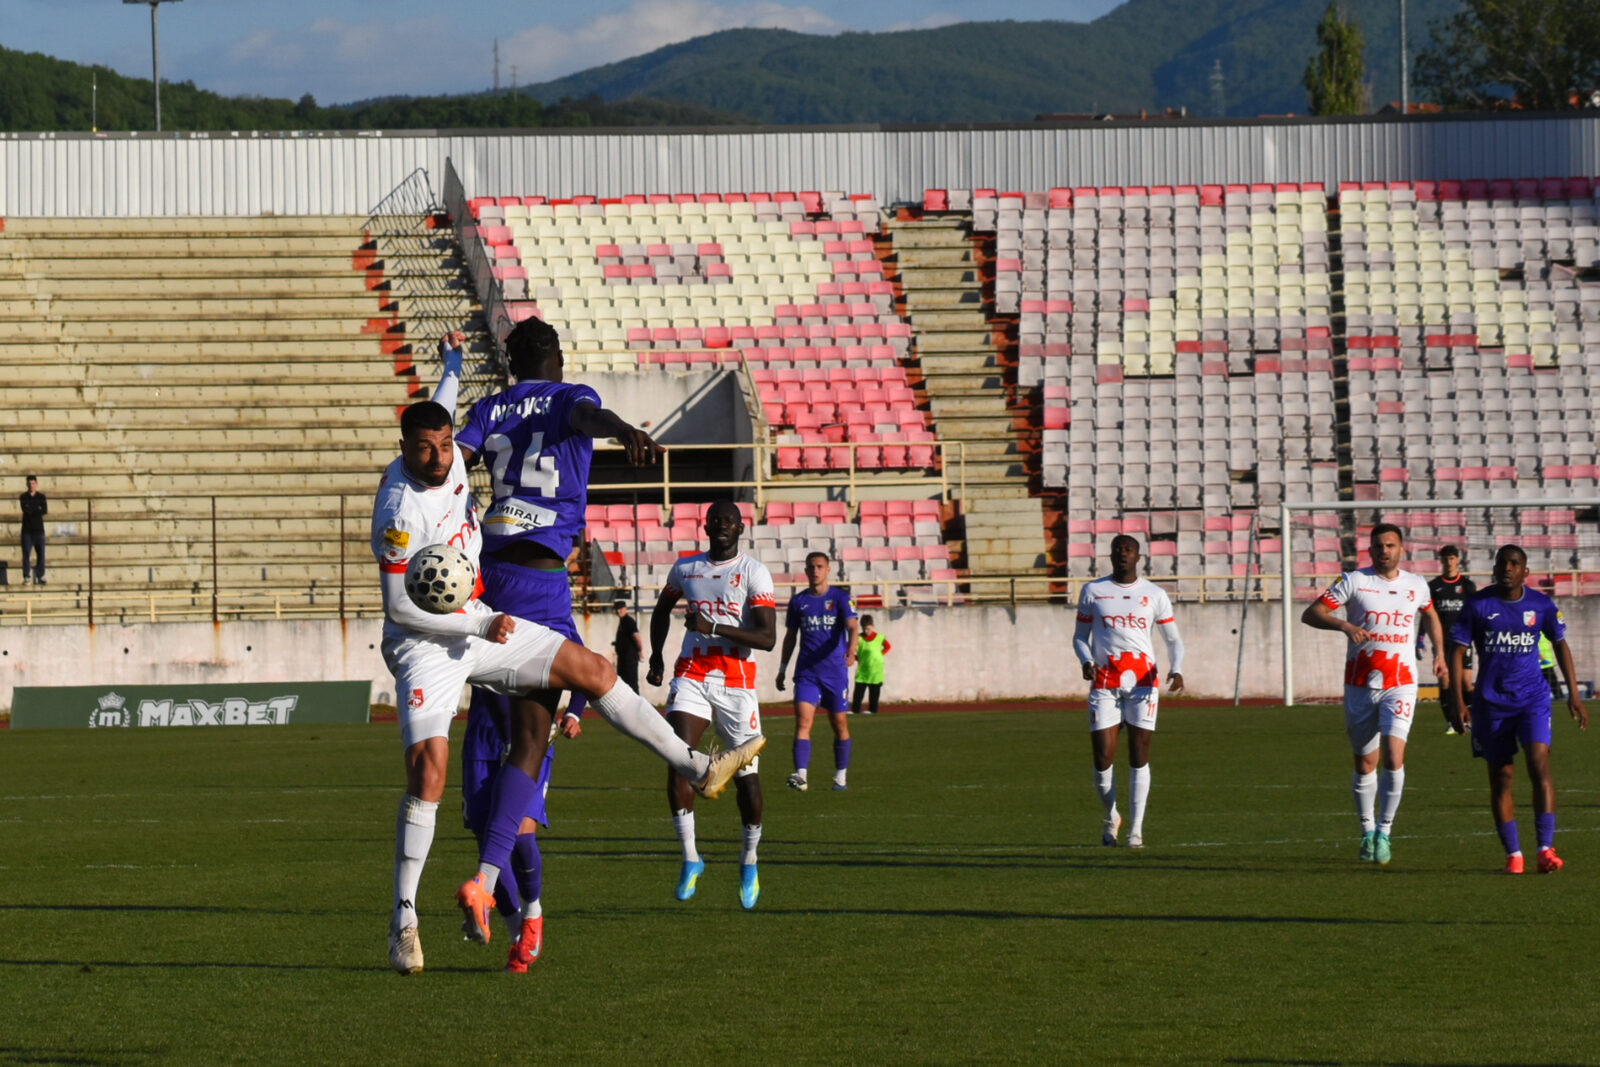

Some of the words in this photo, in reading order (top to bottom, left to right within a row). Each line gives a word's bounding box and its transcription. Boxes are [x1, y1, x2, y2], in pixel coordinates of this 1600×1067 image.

[484, 431, 560, 498] 24
[496, 505, 541, 526] MIRAL
[688, 597, 741, 617] mts
[1102, 612, 1147, 629] mts
[1365, 609, 1413, 627] mts
[1496, 631, 1535, 646] Matis
[138, 696, 298, 727] MAXBET
[1147, 702, 1155, 717] 11
[1395, 700, 1410, 717] 33
[750, 710, 757, 730] 6
